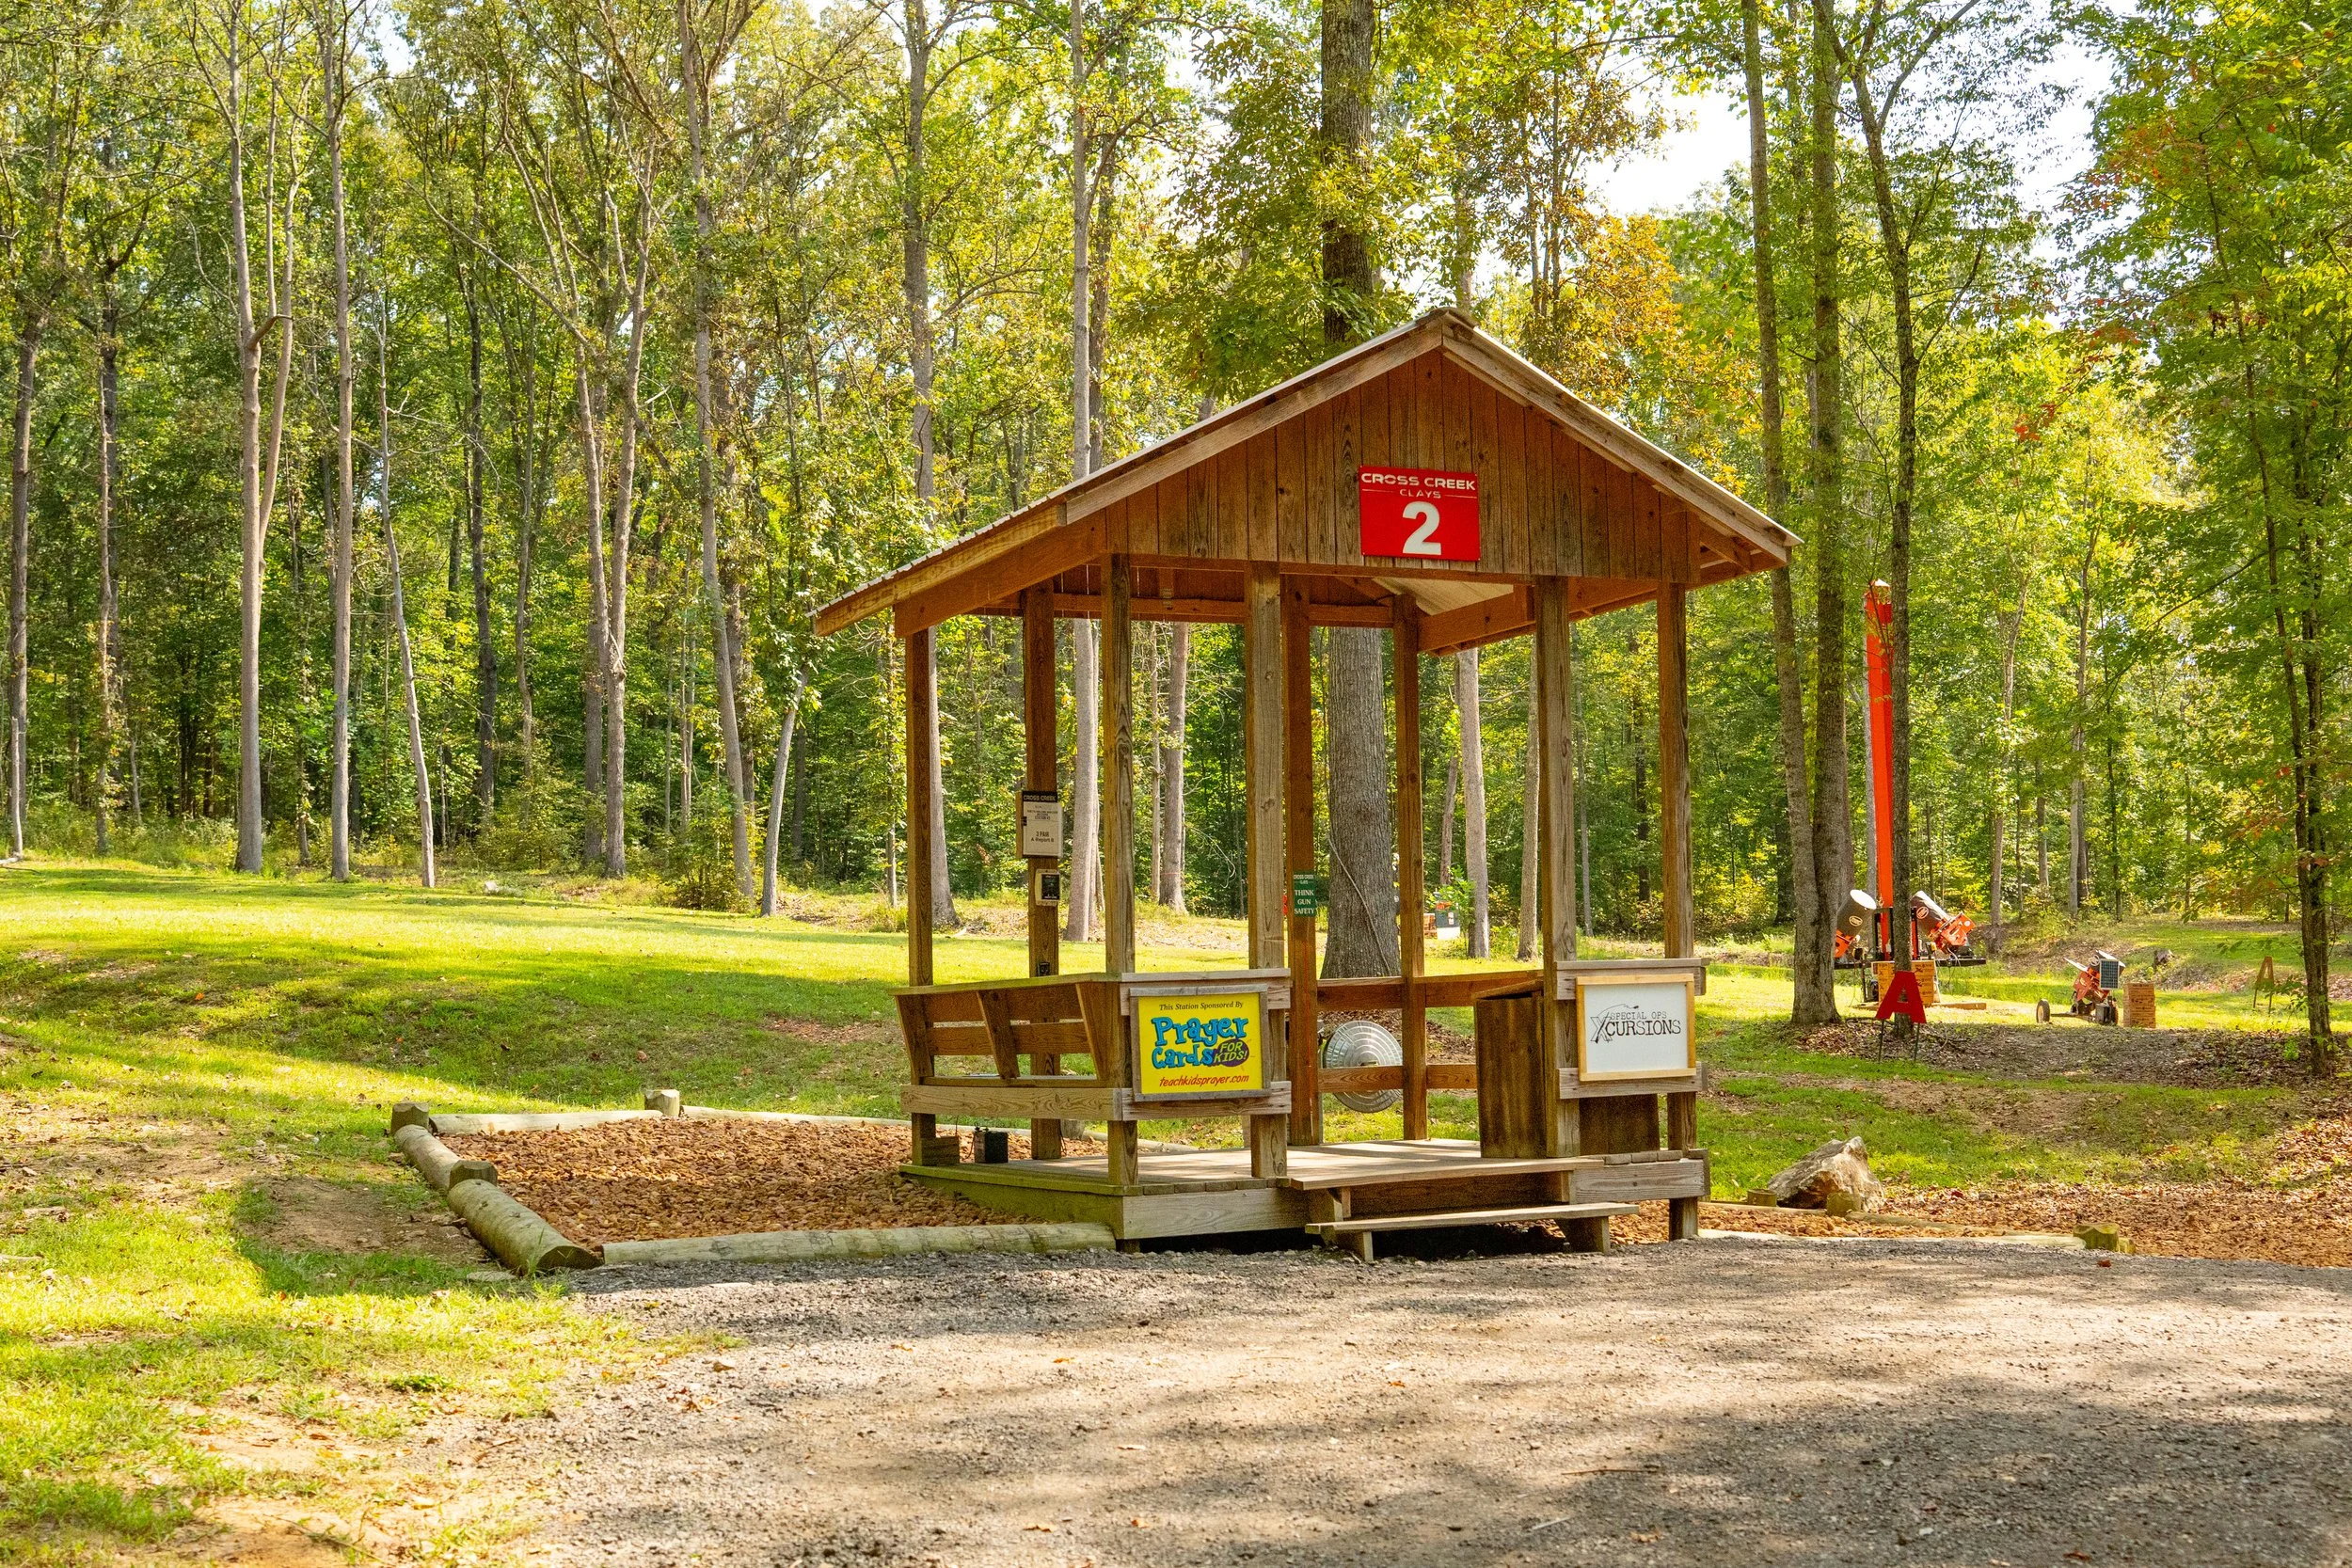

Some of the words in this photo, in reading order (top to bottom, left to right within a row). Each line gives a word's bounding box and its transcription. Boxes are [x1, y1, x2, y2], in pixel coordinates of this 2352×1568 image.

[1361, 473, 1420, 486] CROSS
[1424, 477, 1476, 490] CREEK
[1400, 488, 1441, 499] CLAYS
[1402, 500, 1441, 555] 2
[1875, 971, 1927, 1023] A
[1200, 1002, 1233, 1011] Sponsored
[1235, 1001, 1244, 1009] By
[1610, 1011, 1647, 1021] SPECIAL
[1151, 1017, 1249, 1047] Prayer
[1220, 1041, 1243, 1053] FOR
[1152, 1043, 1215, 1069] Cards
[1214, 1051, 1248, 1063] KIDS!
[1159, 1074, 1249, 1086] teachkidsprayer.com
